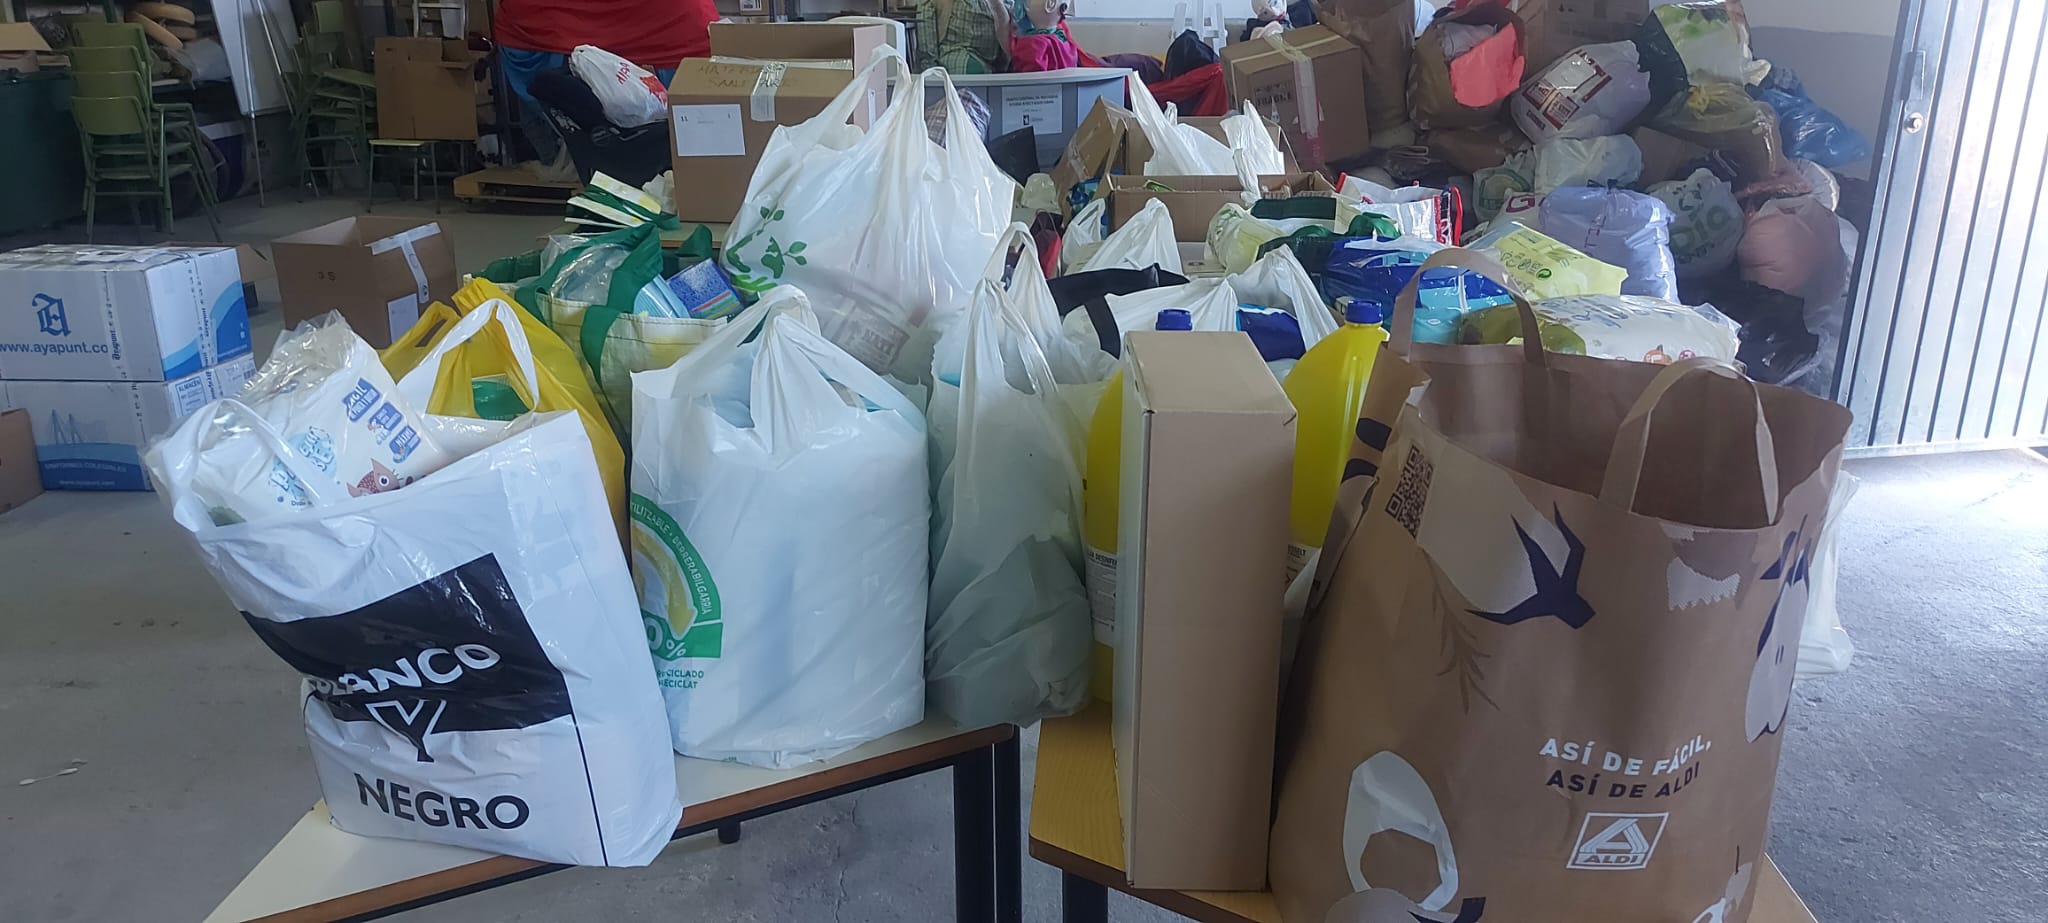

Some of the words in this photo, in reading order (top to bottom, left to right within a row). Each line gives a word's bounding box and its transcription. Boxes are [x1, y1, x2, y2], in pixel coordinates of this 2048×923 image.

[645, 616, 686, 658] 0%
[365, 700, 447, 762] Y
[1539, 738, 1596, 765] ASÍ
[1602, 751, 1643, 776] DE
[1652, 735, 1712, 776] FÁCIL,
[1546, 770, 1601, 796] ASÍ
[1608, 783, 1648, 798] DE
[1654, 762, 1699, 798] ALDI
[354, 773, 530, 830] NEGRO
[1583, 855, 1639, 864] ALDI
